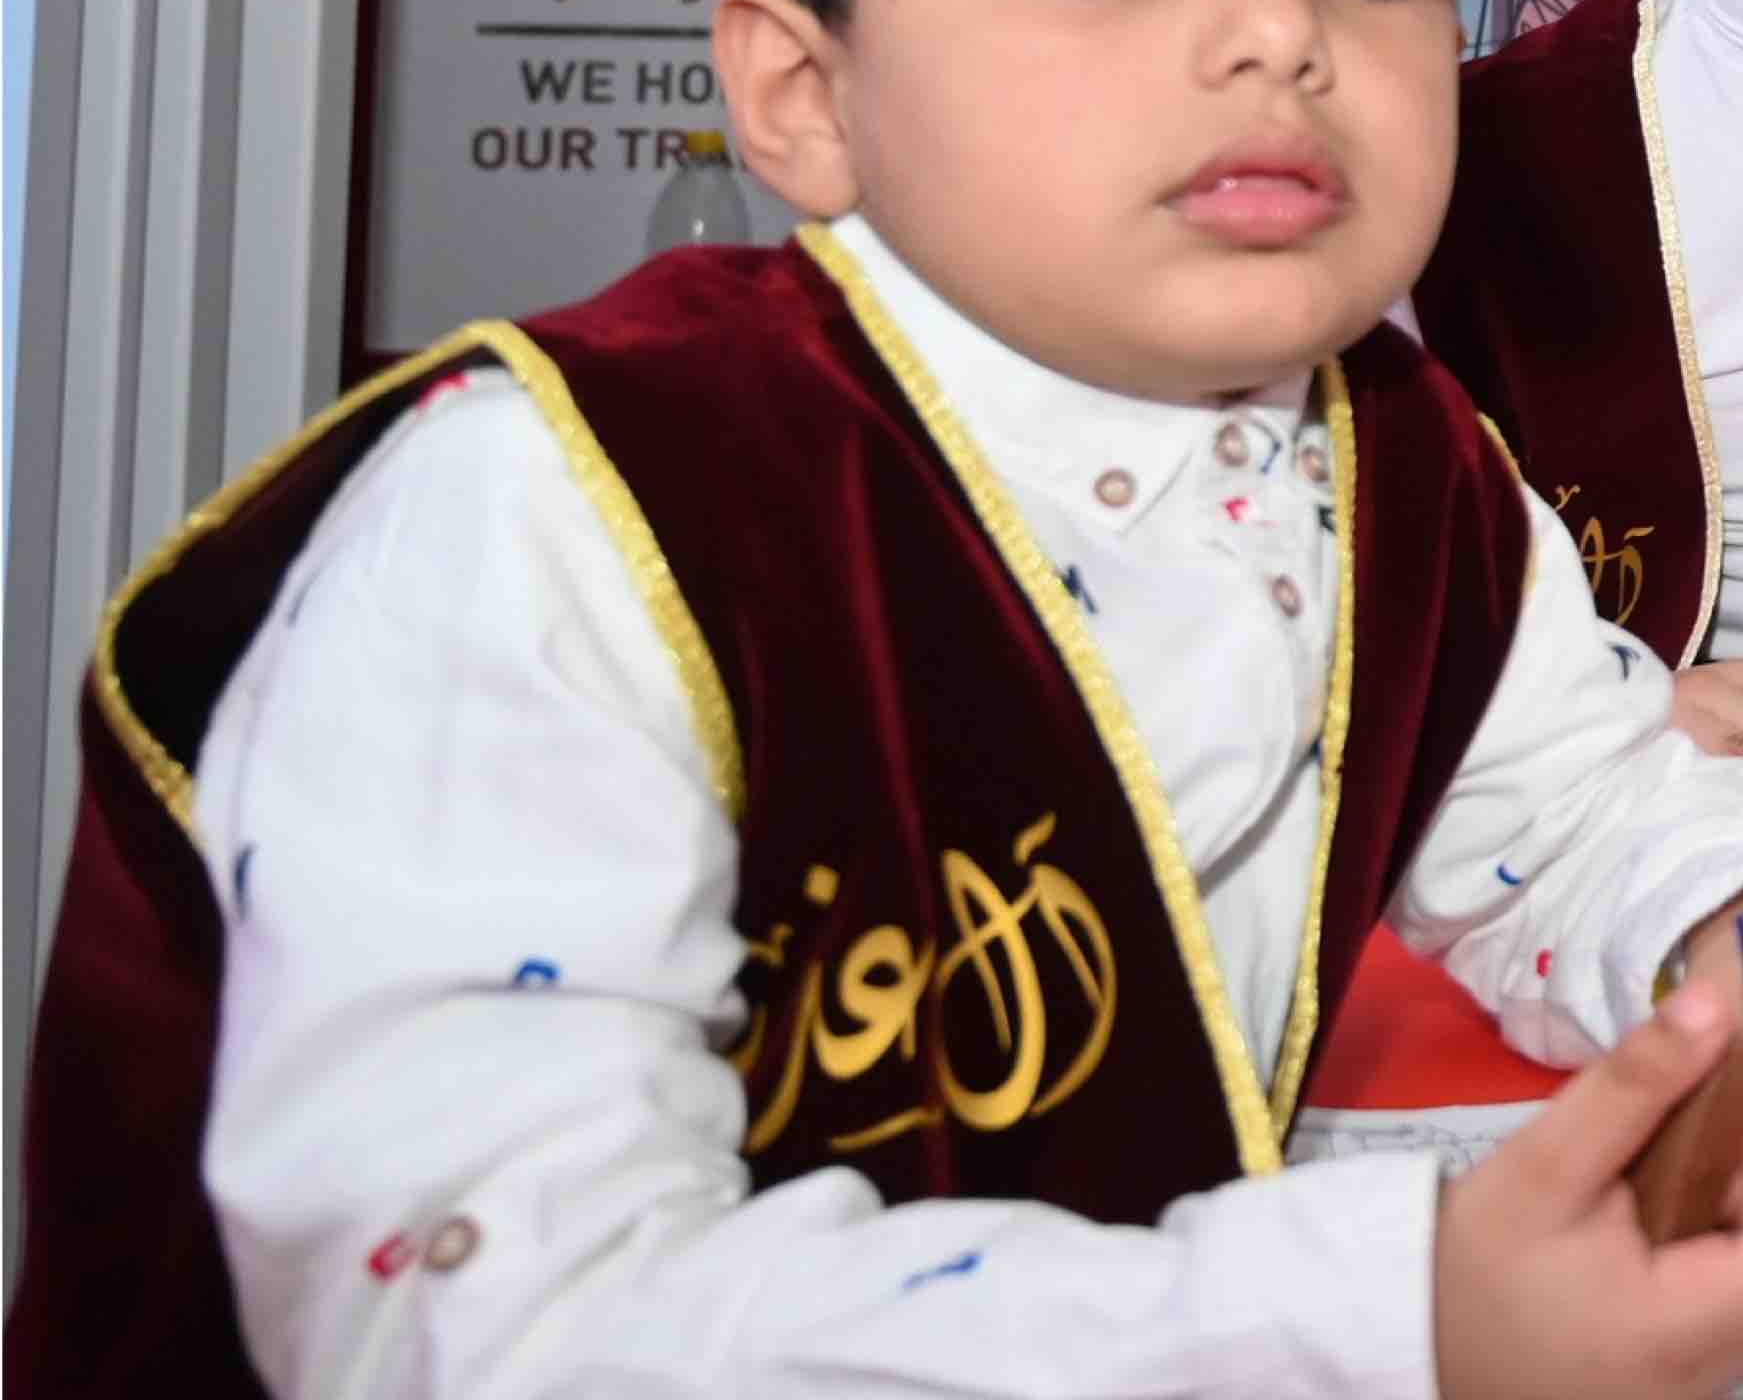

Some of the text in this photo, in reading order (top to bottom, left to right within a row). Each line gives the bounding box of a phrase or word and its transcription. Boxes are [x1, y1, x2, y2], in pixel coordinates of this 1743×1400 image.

[519, 57, 719, 106] WE HO
[471, 125, 597, 173] OUR
